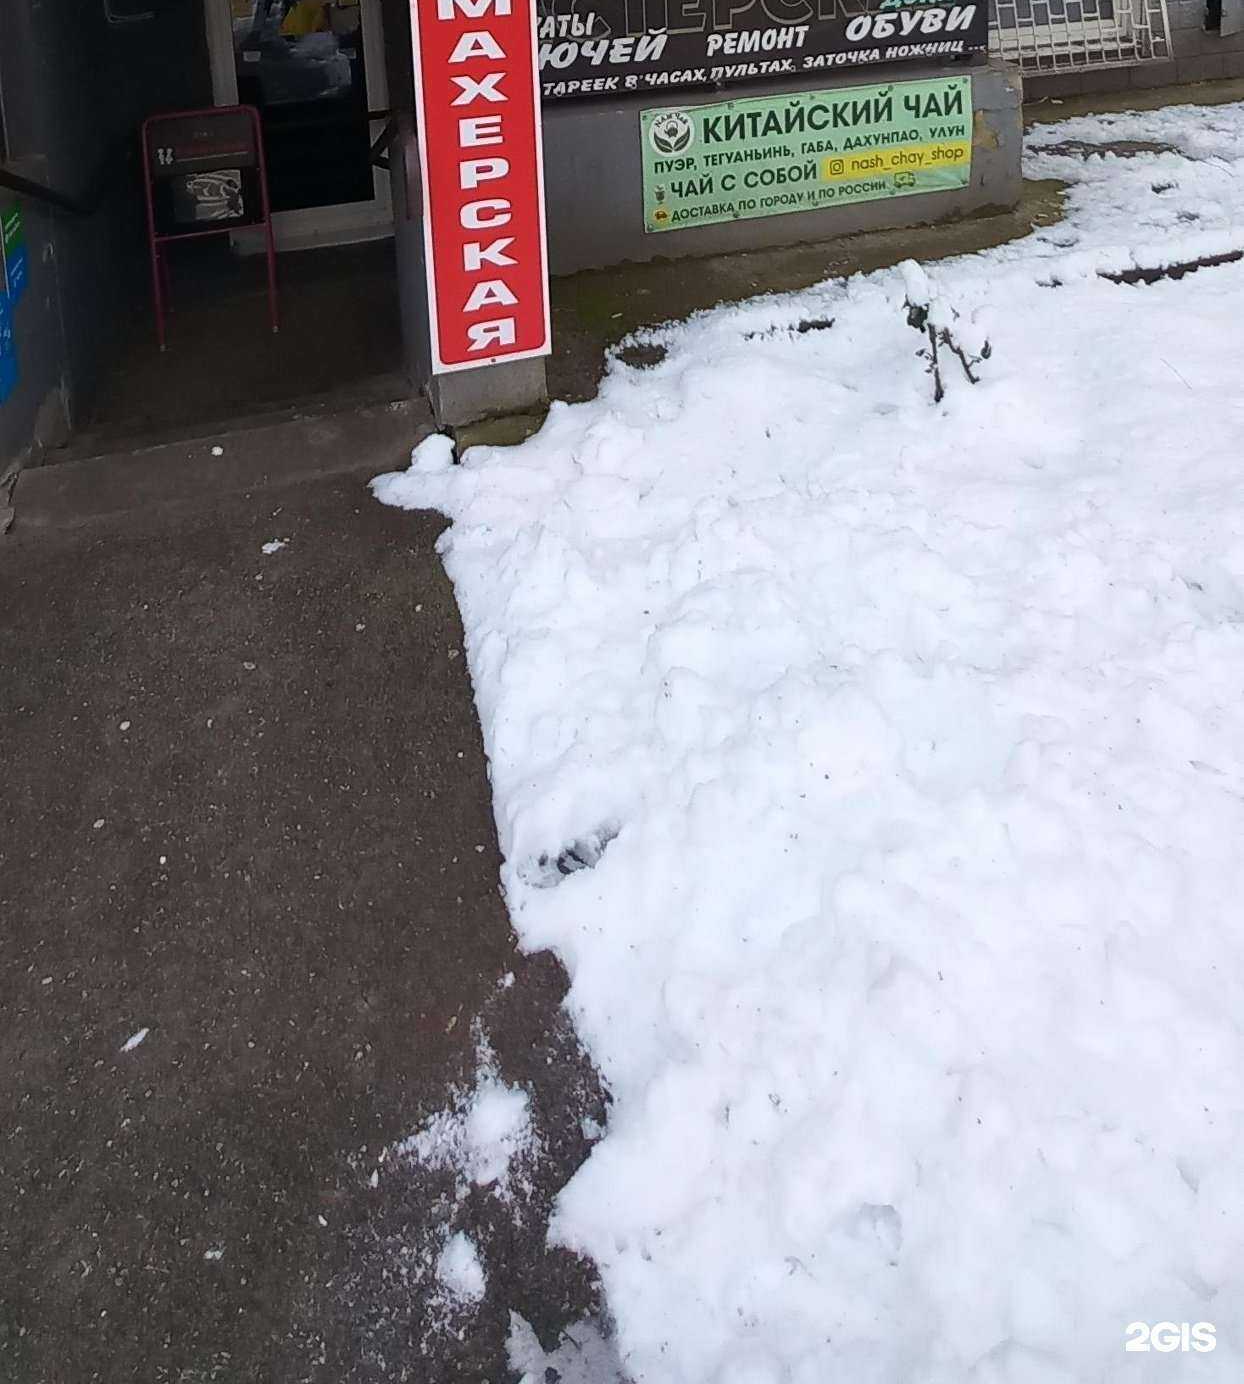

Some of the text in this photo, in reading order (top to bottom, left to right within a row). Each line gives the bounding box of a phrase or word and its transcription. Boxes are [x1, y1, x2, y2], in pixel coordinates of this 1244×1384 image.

[537, 12, 595, 39] АТЫ
[706, 25, 809, 57] РЕМОНТ
[845, 4, 977, 41] ОБУВИ
[803, 47, 880, 68] ЗАТОЧКА
[703, 84, 963, 144] КИТАЙСКИЙ ЧАЙ
[654, 157, 697, 174] ПУЭР,
[703, 144, 795, 167] ТЕГУАНЬИНЬ,
[801, 139, 838, 154] ГАБА,
[930, 124, 965, 139] УЛУН
[851, 145, 964, 171] nash_chay_shop
[671, 159, 817, 198] ЧАЙ С СОБОЙ
[671, 181, 886, 222] ДОСТАВКА ПО ГОРОДУ И ПО РОССИИ
